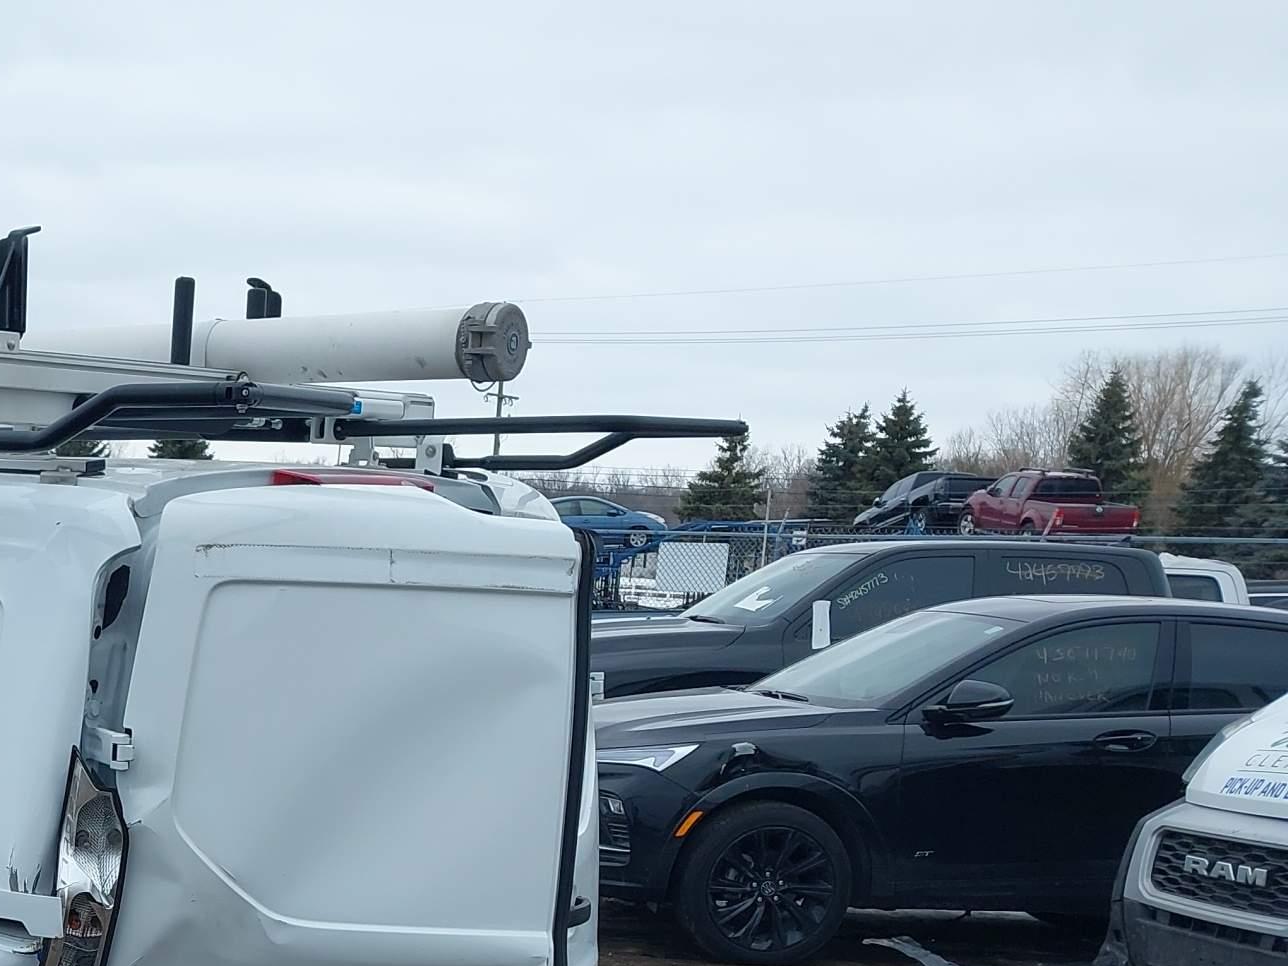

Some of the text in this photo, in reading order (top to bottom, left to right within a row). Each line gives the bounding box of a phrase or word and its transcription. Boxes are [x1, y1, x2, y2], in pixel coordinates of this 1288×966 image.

[1245, 753, 1288, 769] CLE
[1220, 777, 1266, 796] PICK-UP
[1257, 781, 1288, 799] AND
[1183, 855, 1268, 887] RAM
